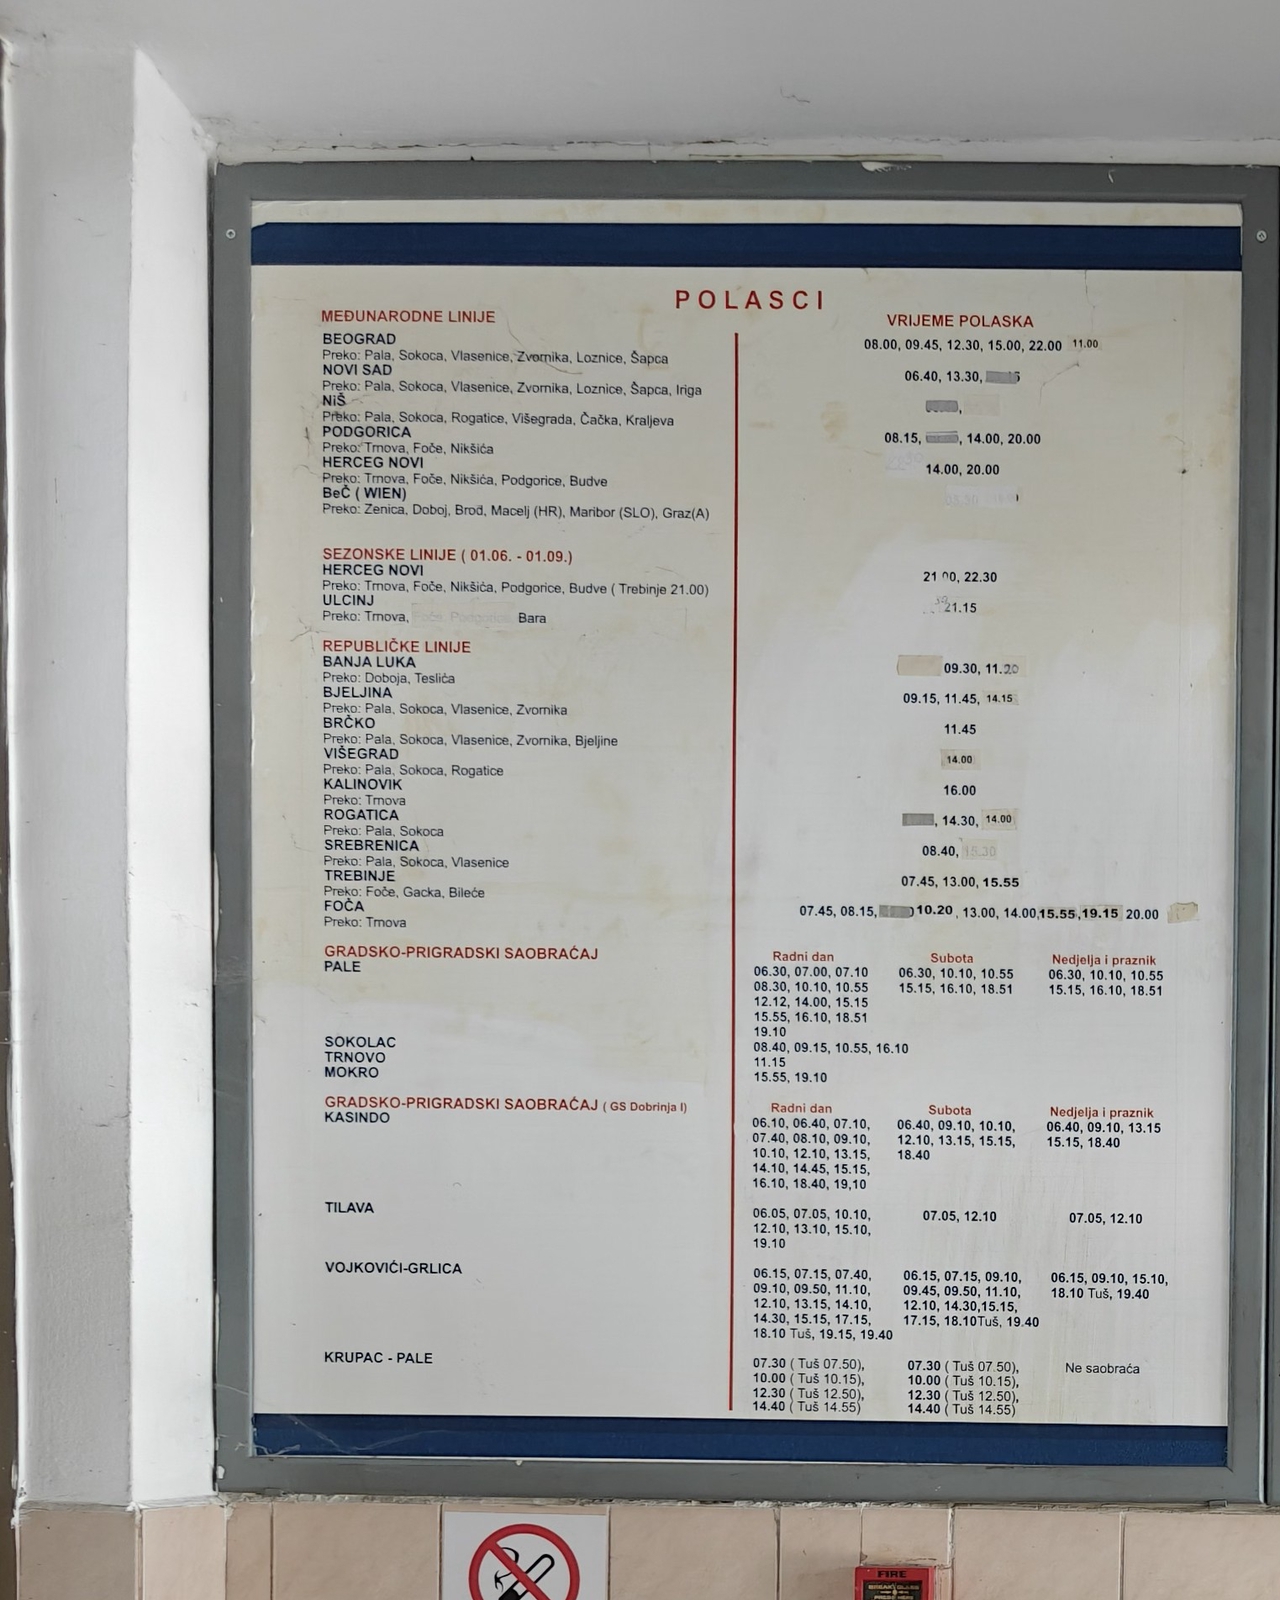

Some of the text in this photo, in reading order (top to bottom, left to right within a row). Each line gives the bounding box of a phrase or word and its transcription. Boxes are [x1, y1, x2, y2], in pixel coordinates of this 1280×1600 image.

[321, 310, 496, 323] MEĐUNARODNE LINIJE
[886, 314, 1034, 328] VRIJEME POLASKA
[323, 332, 396, 345] BEOGRAD
[864, 338, 1099, 353] 08.00, 09.45, 12.30, 15.00, 22.00 11.00
[322, 348, 361, 362] Preko:
[364, 349, 396, 364] Pala,
[398, 349, 448, 364] Sokoca,
[450, 350, 513, 364] Vlasenice,
[576, 351, 627, 366] Loznice,
[630, 349, 669, 368] Šapca
[323, 364, 392, 376] NOVI SAD
[322, 425, 412, 438] PODGORICA
[322, 456, 424, 469] HERCEG NOVI
[322, 594, 374, 606] ULCINJ
[323, 637, 471, 653] REPUBLIČKE LINIJE
[323, 655, 416, 668] BANJA LUKA
[323, 686, 392, 698] BJELJINA
[323, 714, 376, 729] BRČKO
[944, 724, 977, 735] 11.45
[323, 744, 399, 760] VIŠEGRAD
[323, 778, 403, 790] KALINOVIK
[943, 784, 976, 796] 16.00
[324, 808, 400, 821] ROGATICA
[324, 839, 420, 851] SREBRENICA
[324, 869, 396, 882] TREBINJE
[324, 897, 365, 912] FOČA
[324, 944, 598, 960] GRADSKO-PRIGRADSKI SAOBRAĆAJ
[772, 950, 834, 962] Radni dan
[930, 952, 974, 964] Subota
[324, 960, 361, 973] PALE
[1052, 954, 1156, 968] Nedjelja i praznik
[754, 966, 869, 979] 06.30, 07.00, 07.10
[324, 1036, 396, 1048] SOKOLAC
[324, 1051, 386, 1063] TRNOVO
[324, 1066, 379, 1078] MOKRO
[324, 1111, 390, 1123] KASINDO
[324, 1201, 375, 1214] TILAVA
[922, 1210, 997, 1224] 07.05, 12.10
[324, 1259, 463, 1274] VOJKOVIĆI-GRLICA
[1065, 1362, 1140, 1374] Ne saobraća
[877, 1570, 907, 1578] FIRE
